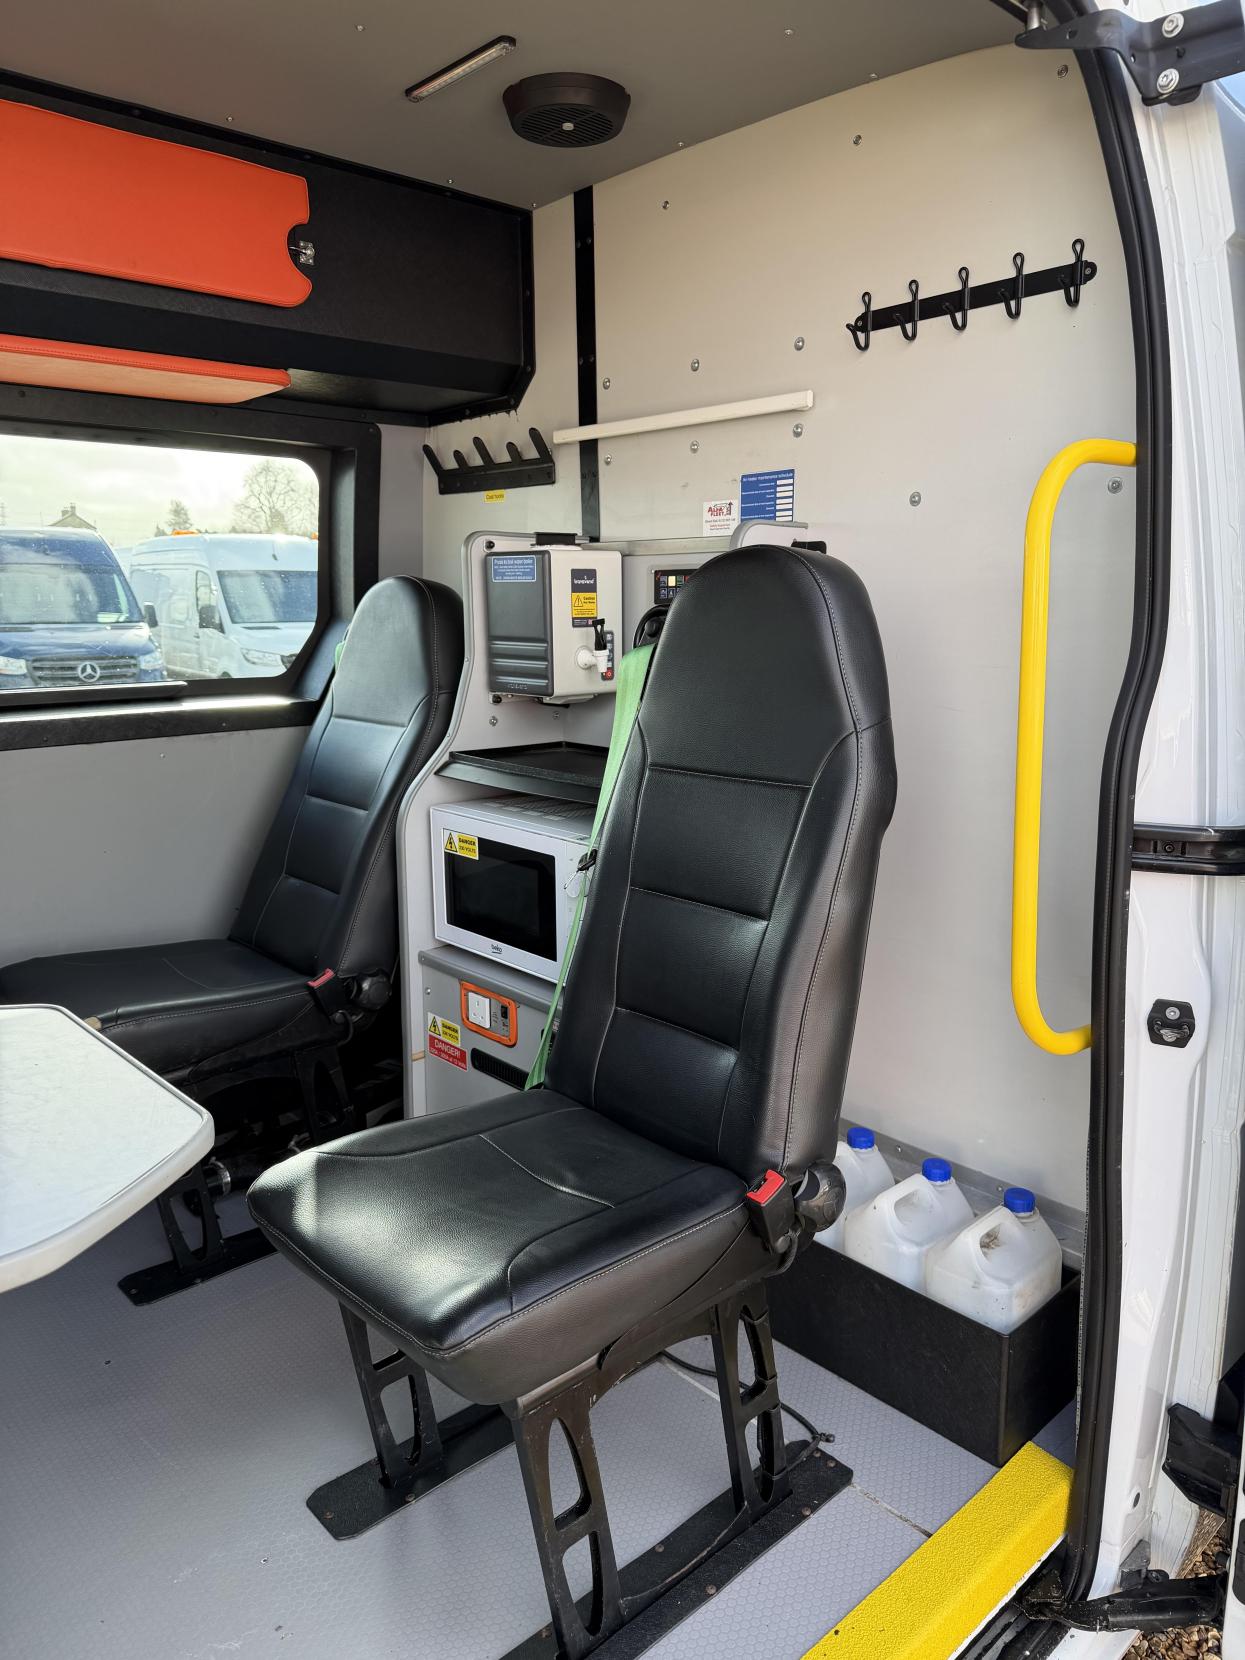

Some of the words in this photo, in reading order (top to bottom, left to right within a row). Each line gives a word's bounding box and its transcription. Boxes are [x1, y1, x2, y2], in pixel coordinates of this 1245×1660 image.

[458, 837, 477, 847] DANGER
[491, 944, 503, 953] beko
[441, 1022, 459, 1034] DANGER
[434, 1039, 461, 1058] DANGER!
